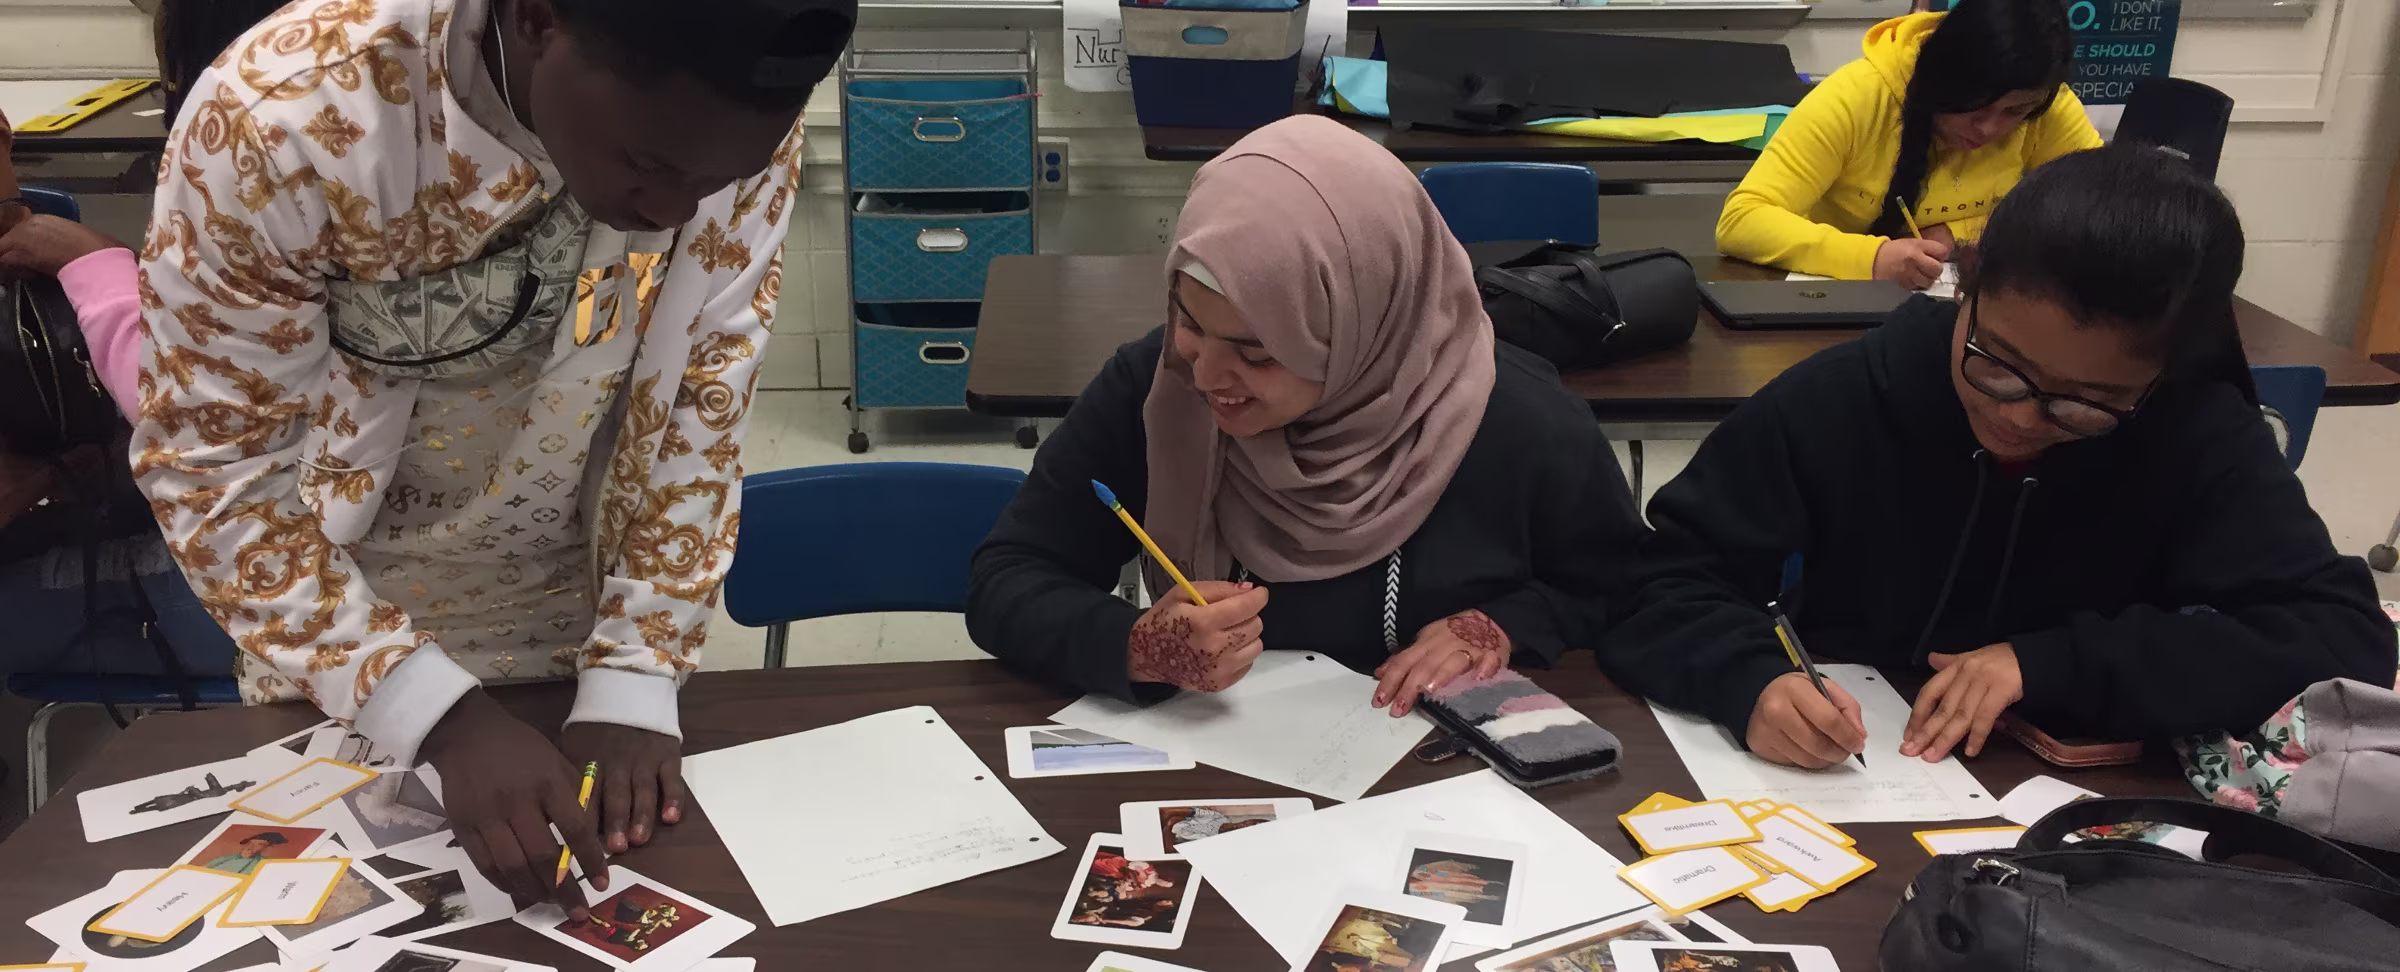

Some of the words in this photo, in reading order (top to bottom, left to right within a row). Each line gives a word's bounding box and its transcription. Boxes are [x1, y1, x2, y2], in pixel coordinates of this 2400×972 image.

[2110, 17, 2144, 31] LIKE
[2088, 43, 2156, 58] SHOULD
[2079, 63, 2109, 76] YOU
[2112, 63, 2152, 76] HAVE
[2072, 82, 2134, 98] SPECIA
[1665, 819, 1717, 832] Dreamlike
[1776, 835, 1822, 862] Awkward
[1673, 865, 1716, 884] Dramatic
